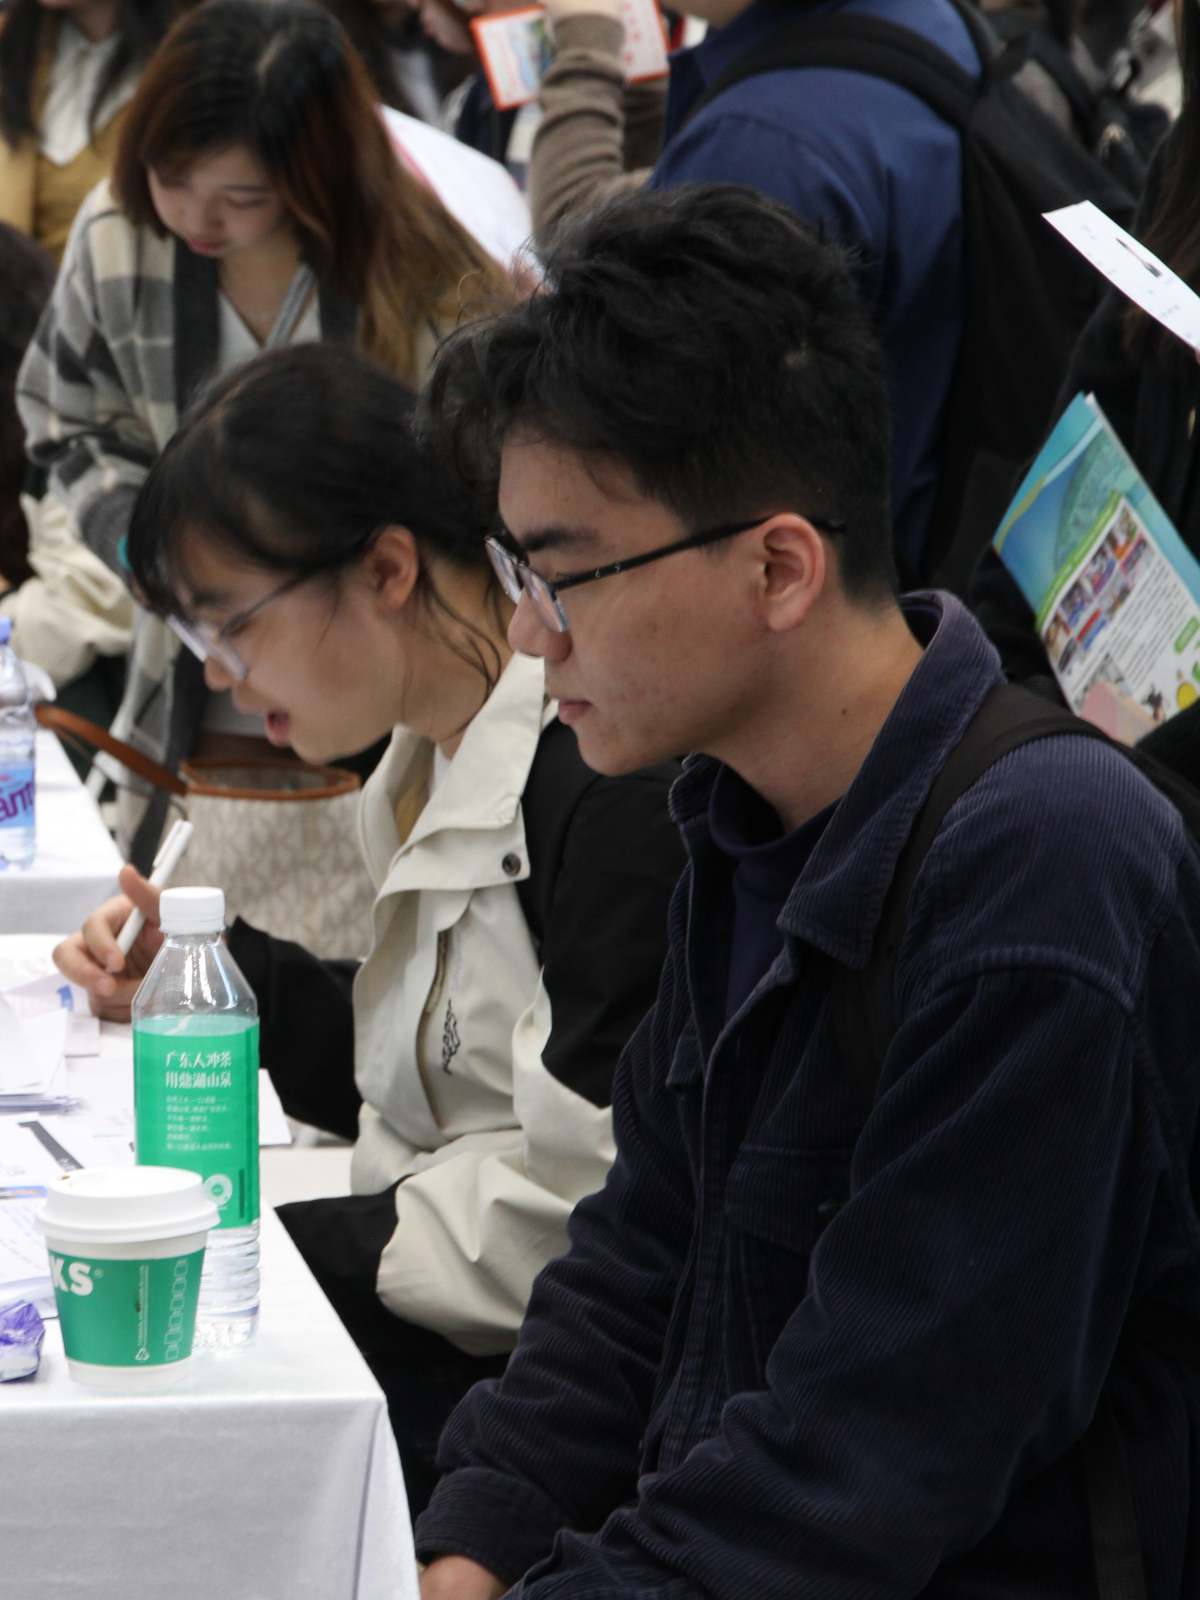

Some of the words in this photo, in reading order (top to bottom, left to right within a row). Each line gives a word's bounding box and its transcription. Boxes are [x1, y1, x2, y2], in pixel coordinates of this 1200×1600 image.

[165, 1050, 232, 1069] 广东人冲茶
